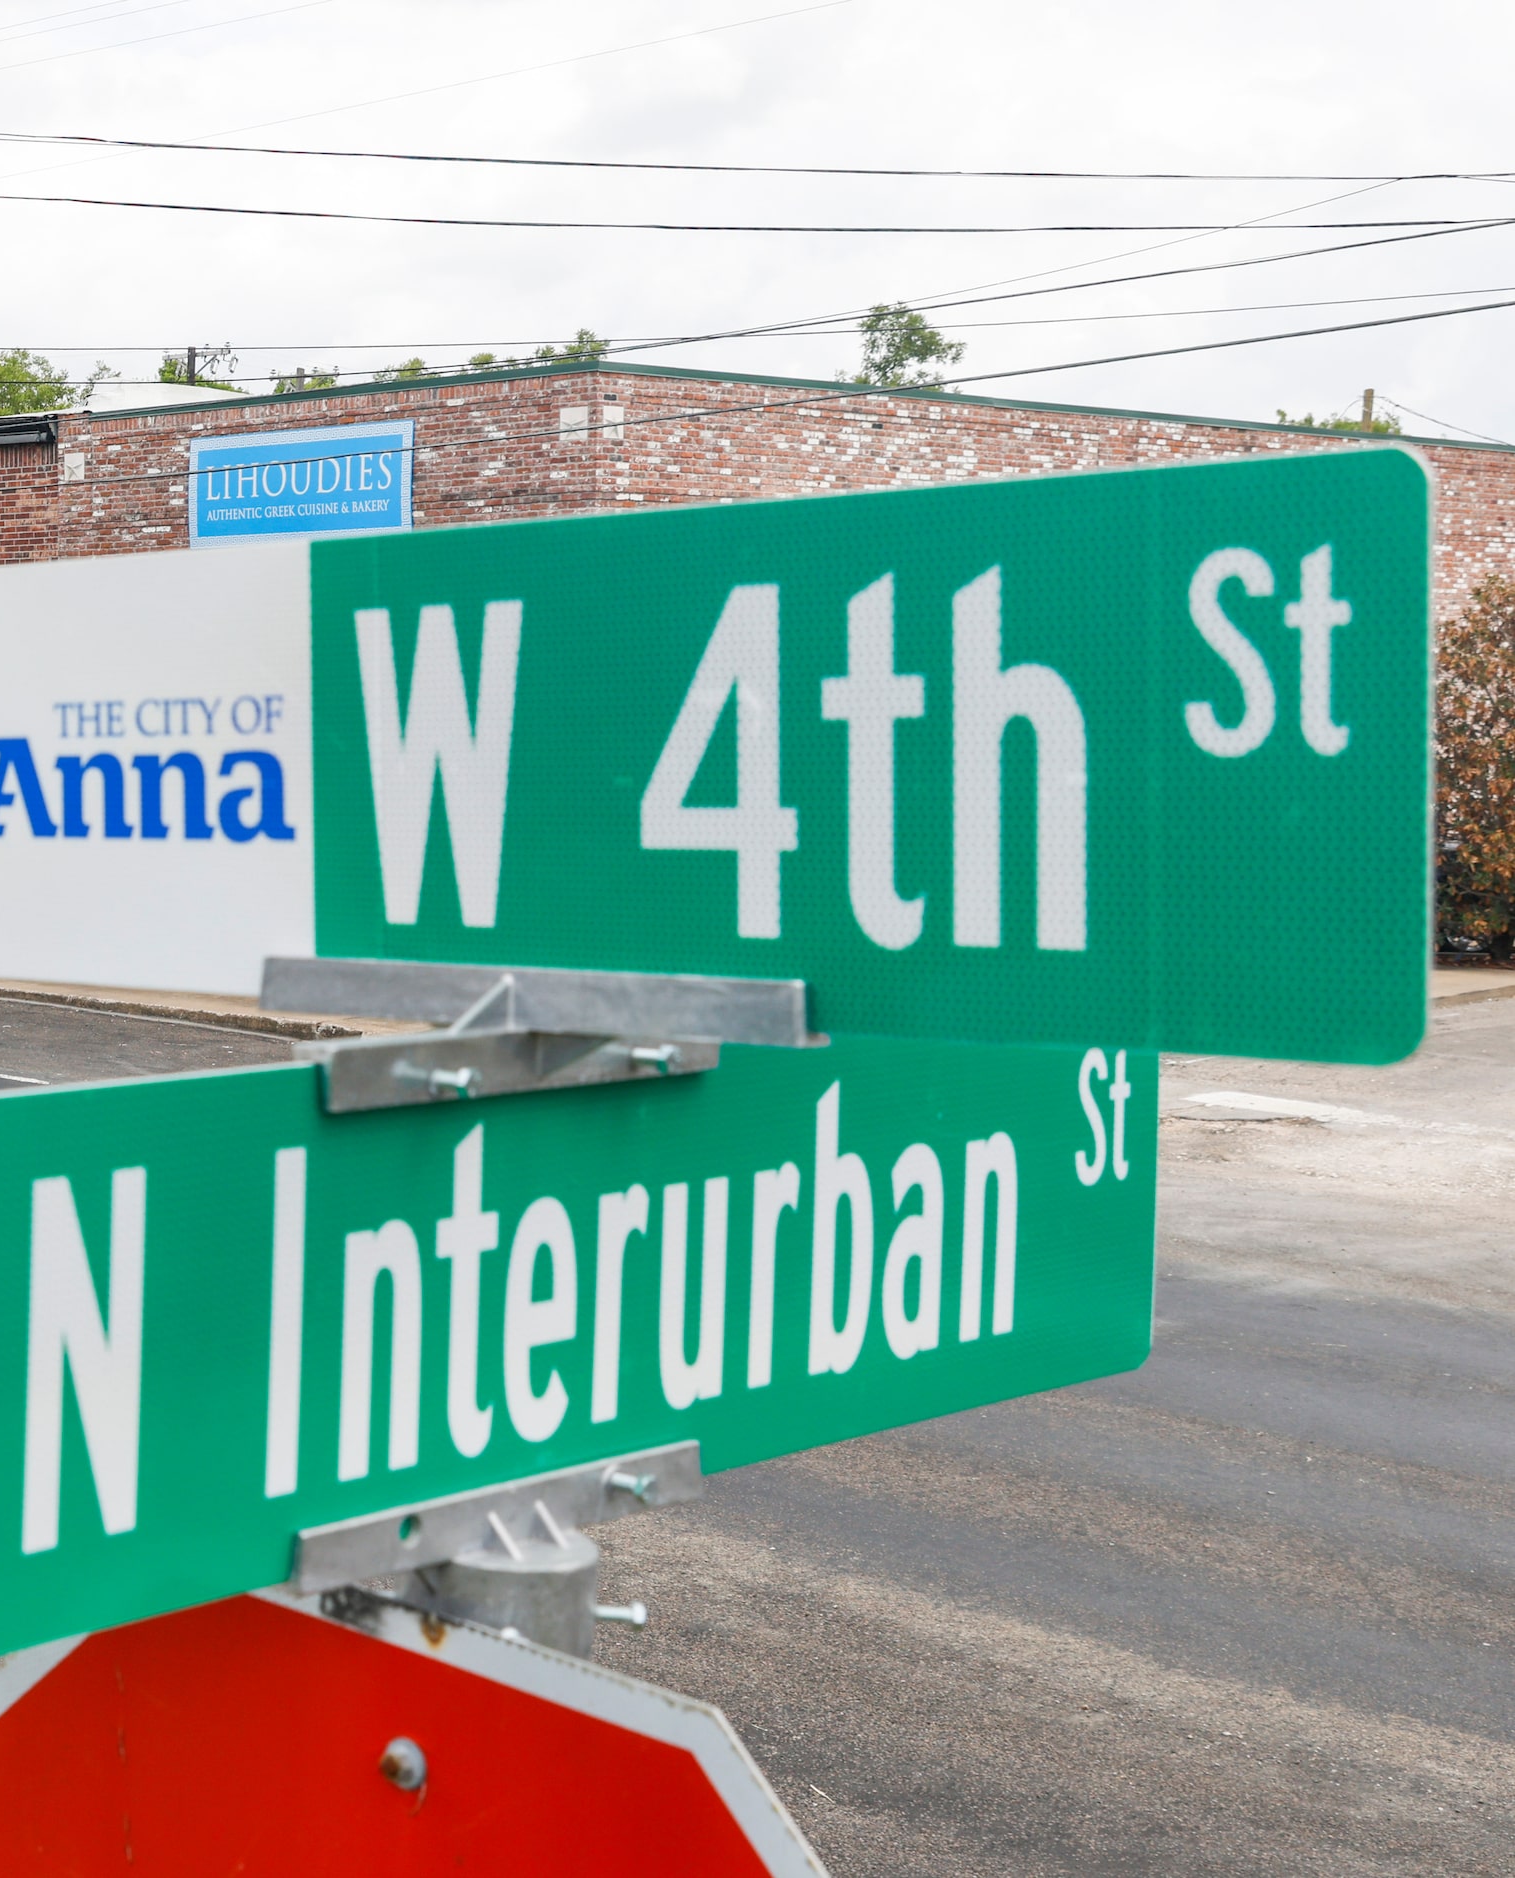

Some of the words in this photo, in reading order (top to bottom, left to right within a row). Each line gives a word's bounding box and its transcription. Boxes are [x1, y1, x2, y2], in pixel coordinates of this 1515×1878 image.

[206, 452, 393, 501] LIHOUDIES
[206, 506, 262, 521] AUTHENTIC
[264, 504, 296, 518] GREEK
[297, 502, 340, 516] CUISINE
[341, 501, 350, 514] &
[351, 499, 390, 513] BAKERY
[53, 700, 126, 738] THE
[135, 696, 222, 737] CITY
[230, 694, 284, 736] OF
[355, 600, 523, 928] W
[641, 567, 1087, 950] 4th
[1186, 545, 1351, 756] St
[23, 1166, 146, 1555] N
[266, 1082, 1018, 1498] Interurban
[1075, 1047, 1132, 1186] St
